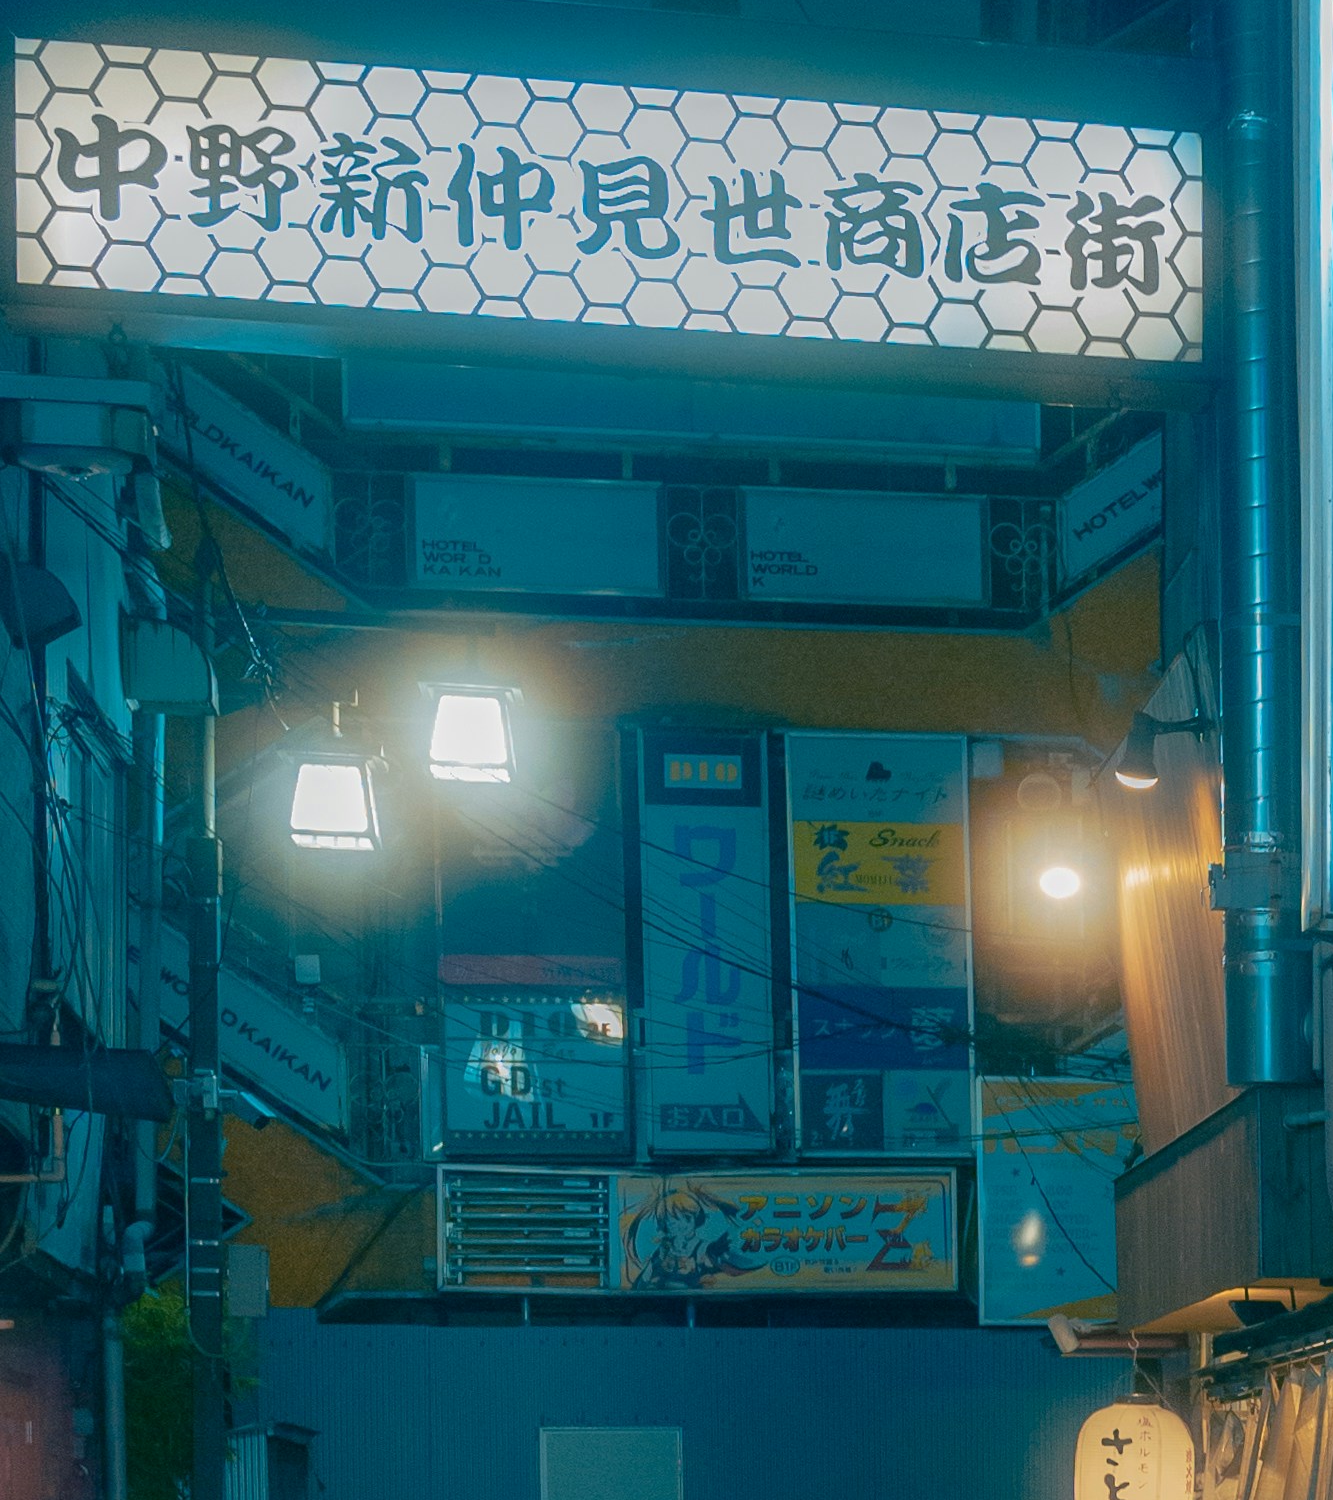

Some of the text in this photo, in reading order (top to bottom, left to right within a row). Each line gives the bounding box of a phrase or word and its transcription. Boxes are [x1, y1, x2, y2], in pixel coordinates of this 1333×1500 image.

[53, 113, 1167, 298] 中野新仲見世商店街
[422, 539, 484, 553] HOTEL
[750, 549, 810, 563] HOTEL
[423, 552, 491, 565] WORD
[423, 564, 501, 577] KAKAN
[751, 563, 819, 576] WORLD
[868, 828, 944, 849] Snack
[673, 823, 742, 1075] ワールド
[484, 1102, 566, 1129] JAIL
[739, 1194, 868, 1221] アニソン
[740, 1226, 869, 1253] カラオケバー
